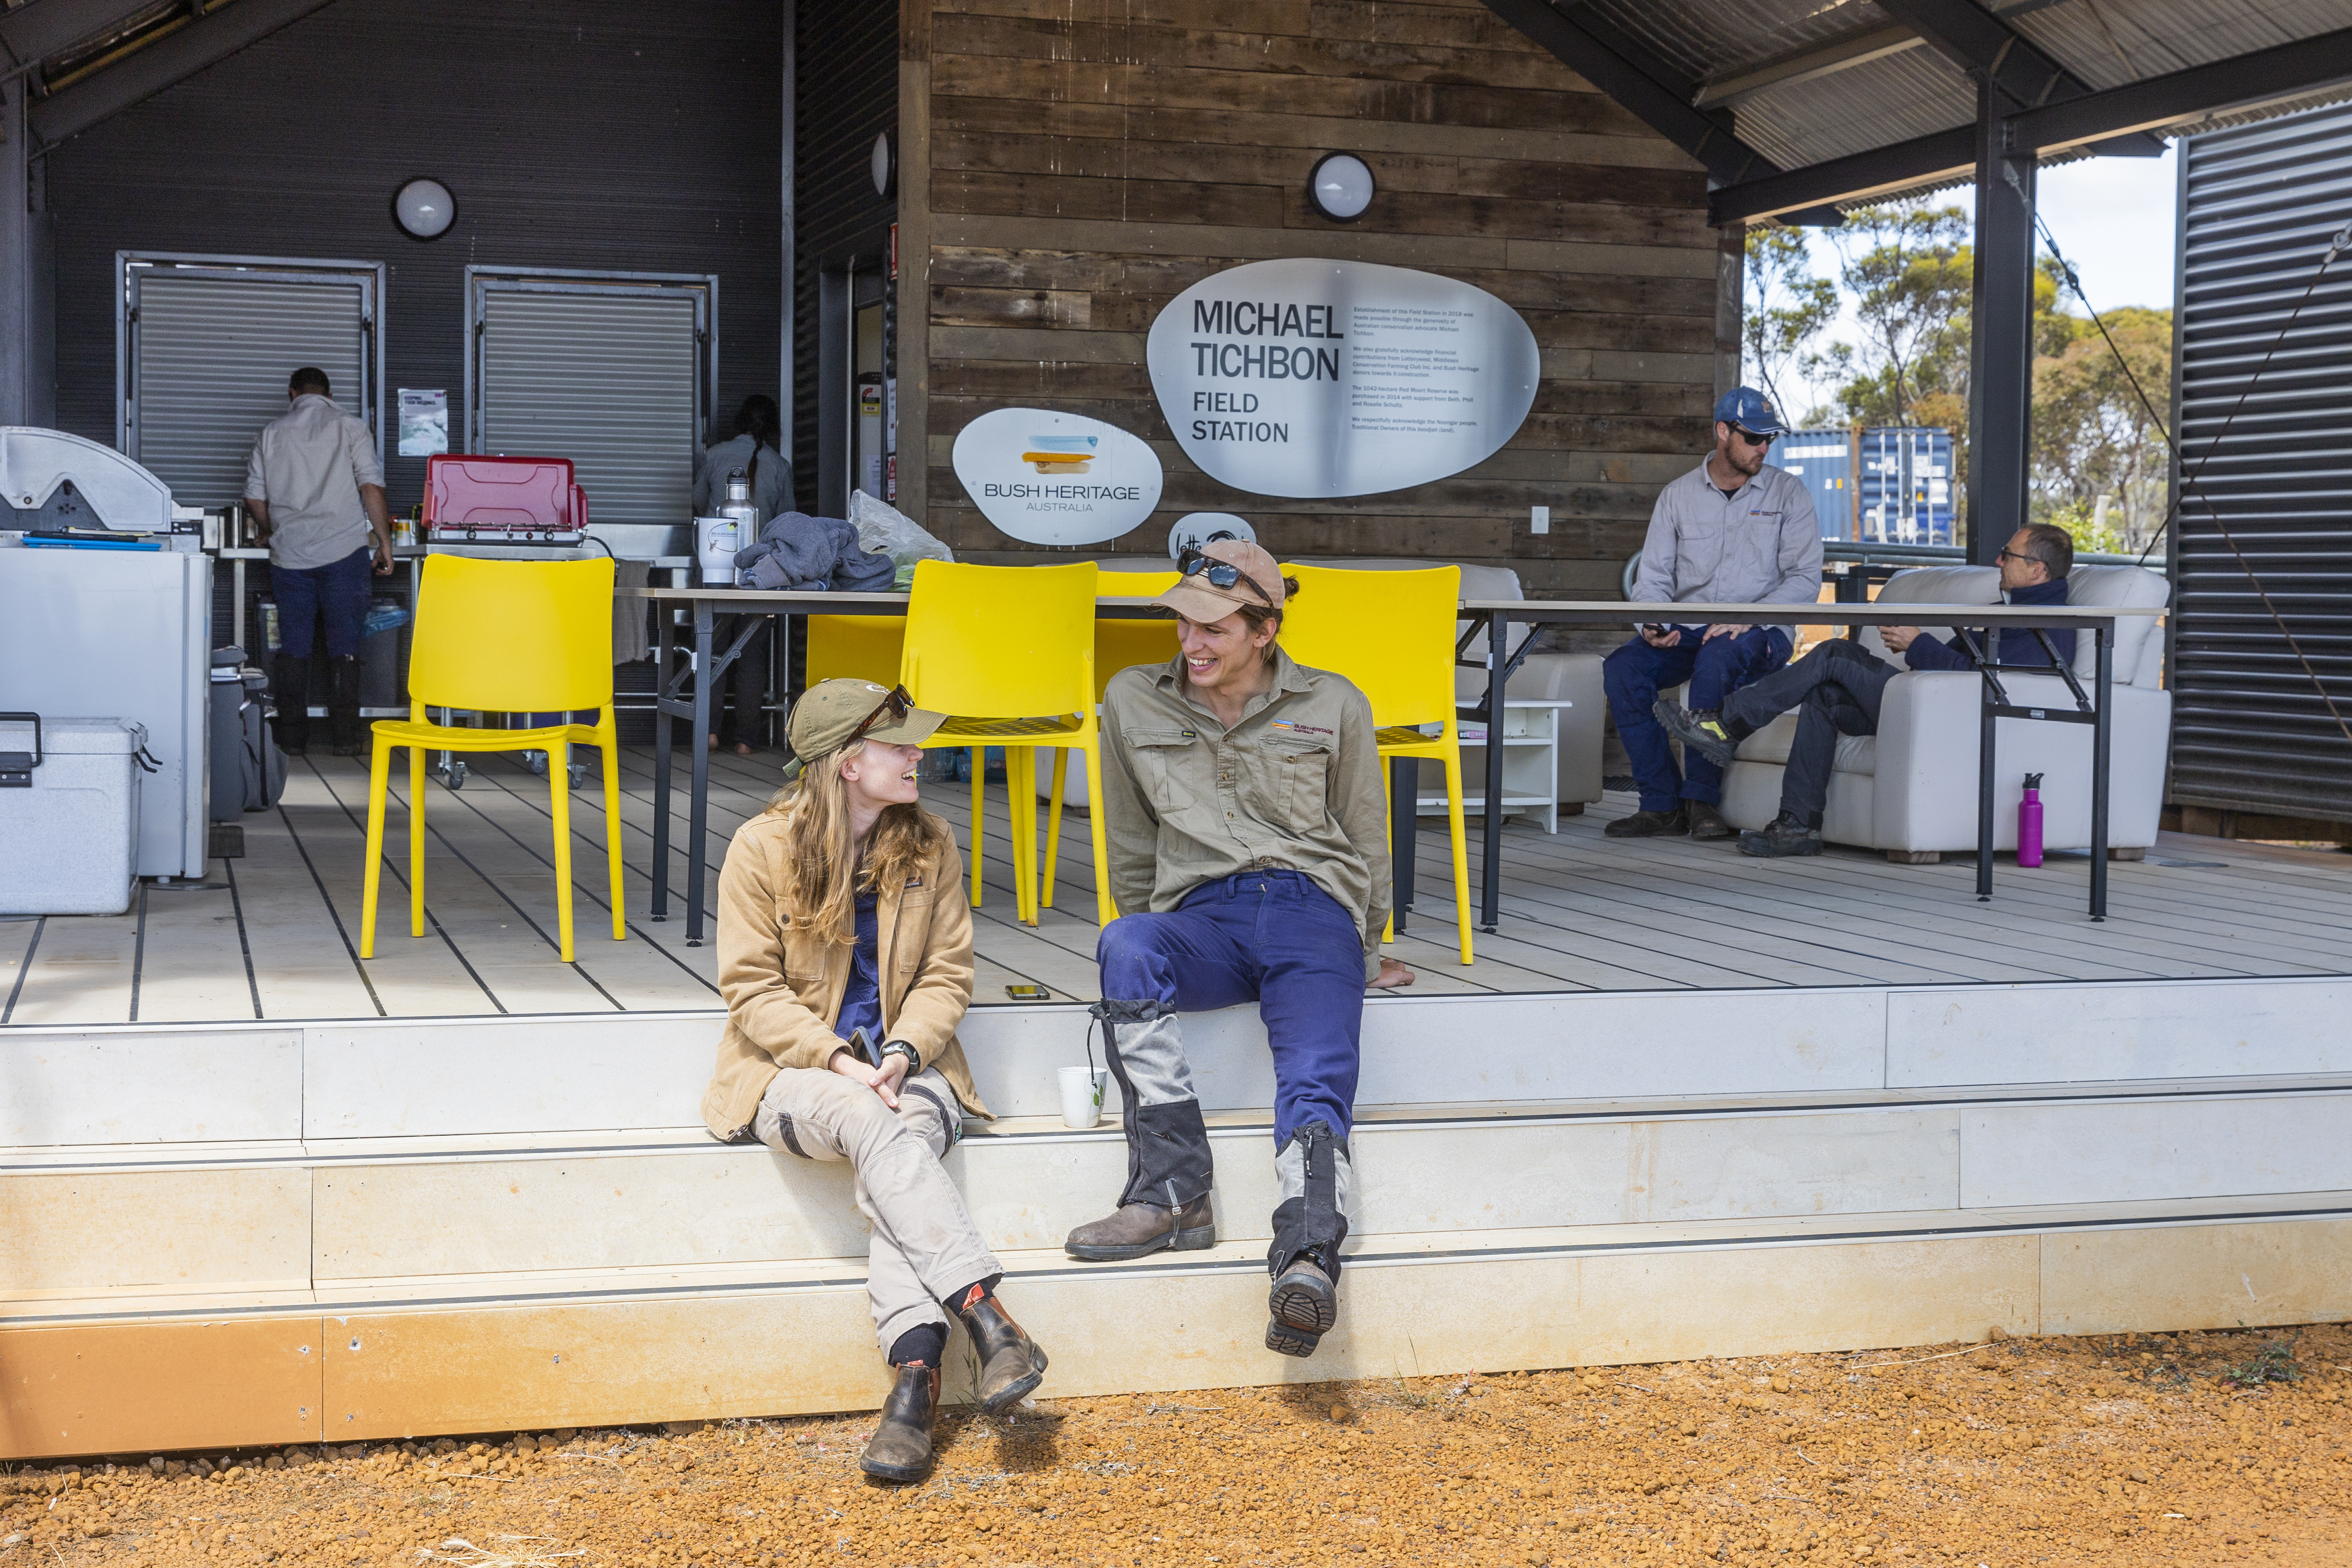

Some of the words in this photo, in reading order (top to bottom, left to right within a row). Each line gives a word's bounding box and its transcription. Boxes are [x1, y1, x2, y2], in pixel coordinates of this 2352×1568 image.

[1194, 300, 1344, 339] MICHAEL
[1191, 342, 1339, 381] TICHBON
[1194, 392, 1258, 413] FIELD
[1192, 420, 1288, 442] STATION
[985, 484, 1039, 497] BUSH
[1046, 485, 1139, 500] HERITAGE
[1026, 502, 1093, 512] AUSTRALIA
[1309, 726, 1333, 735] HERITAGE
